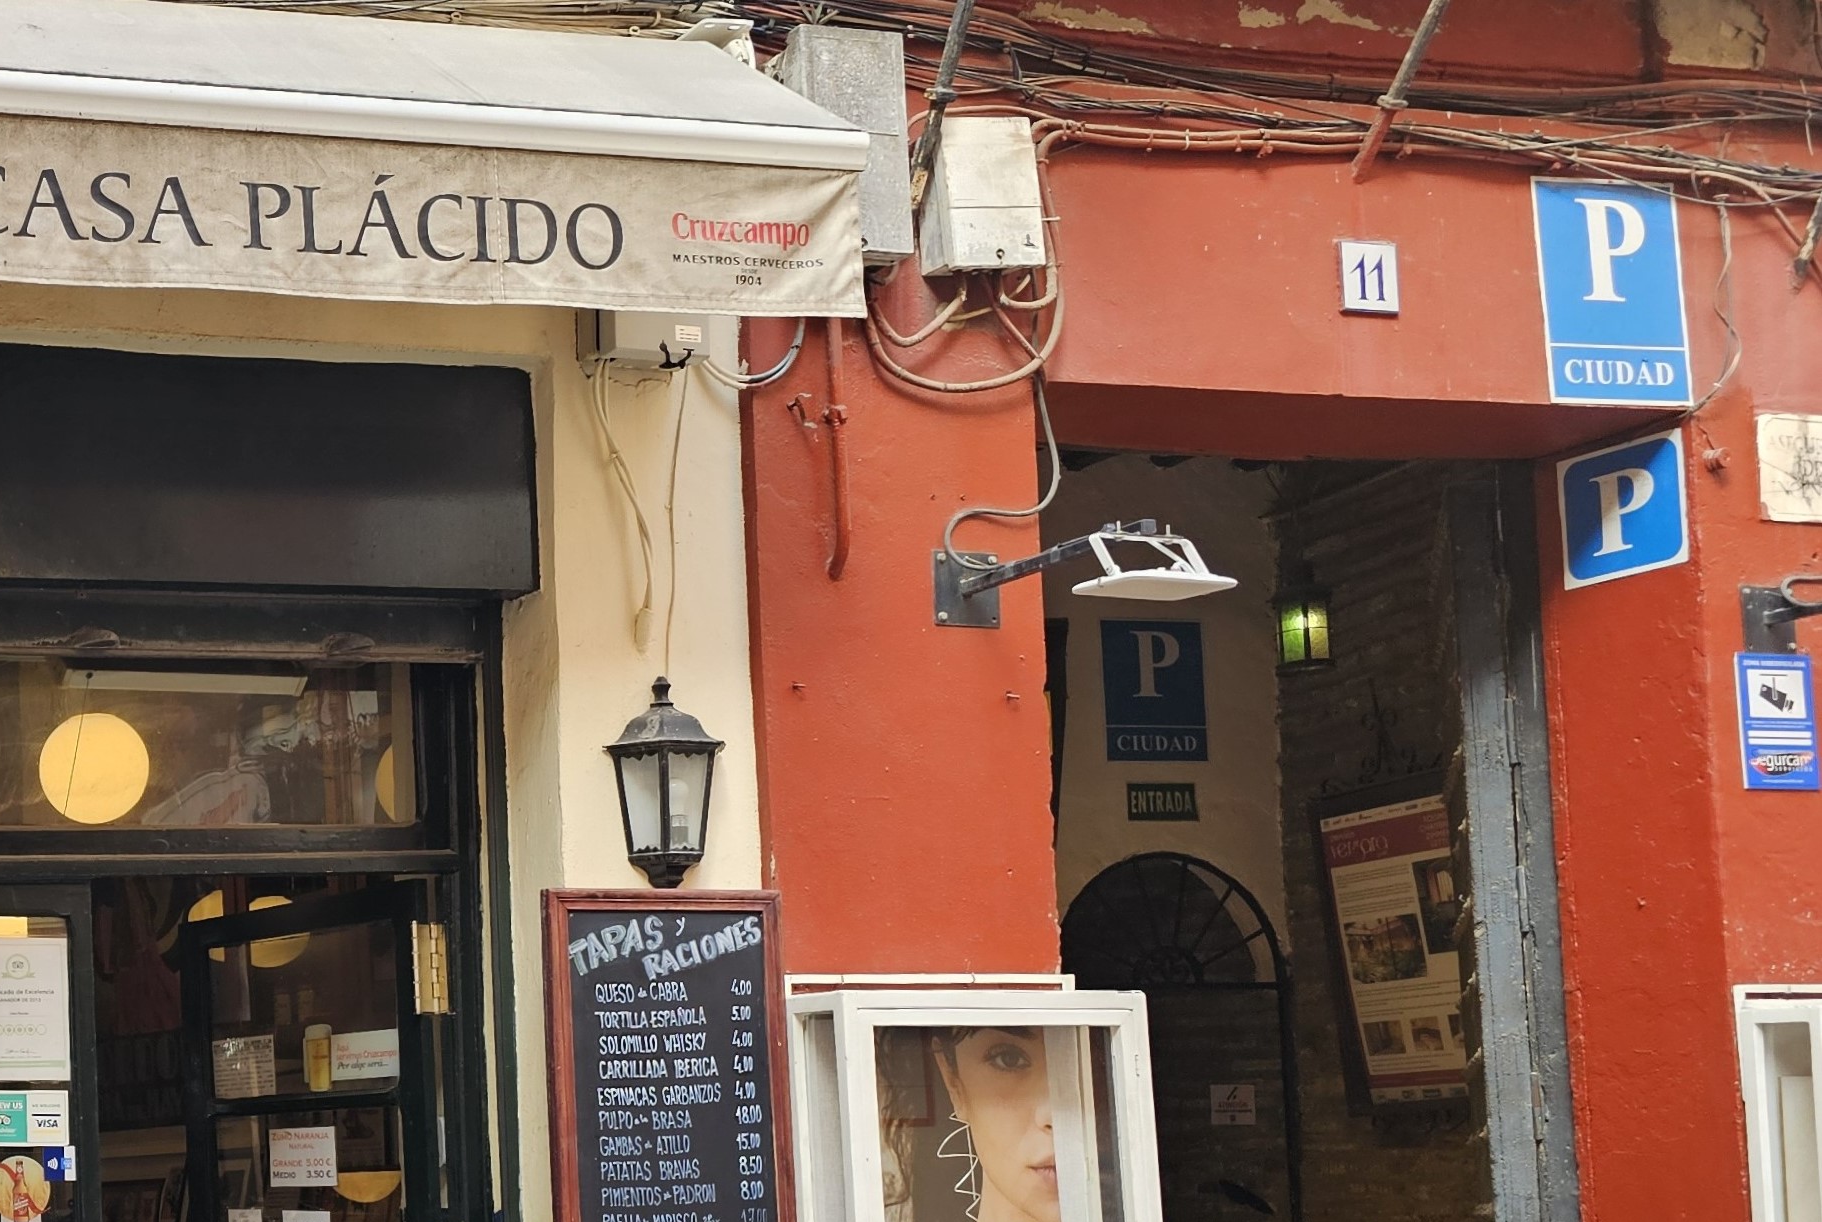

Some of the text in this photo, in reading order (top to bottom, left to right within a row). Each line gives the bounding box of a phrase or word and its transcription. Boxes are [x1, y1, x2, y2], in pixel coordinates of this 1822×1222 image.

[240, 174, 625, 271] PLÁCIDO
[671, 212, 810, 251] Cruzcampo
[672, 253, 824, 270] MAESTROS CERVECEROS
[1574, 198, 1645, 303] P
[735, 274, 762, 286] 1904
[1350, 252, 1386, 302] 11
[1564, 359, 1675, 387] CIUDAD
[1588, 467, 1654, 557] P
[1129, 630, 1180, 698] P
[1116, 734, 1198, 752] CIUDAD
[1130, 791, 1195, 813] ENTRADA
[568, 915, 664, 976] TAPAS
[641, 916, 762, 981] RACIONES
[595, 984, 634, 1004] QUESO
[649, 981, 688, 1001] CABRA
[731, 978, 752, 996] 4.00
[594, 1005, 751, 1029] TORTILLA ESPAÑOLA 5.00
[599, 1029, 753, 1055] SOLOMILLO WHISKY 4.00
[599, 1054, 754, 1079] CARRILLADA IBERICA 4.00
[597, 1081, 756, 1107] ESPINACAS GARBANZOS 4.00
[37, 1119, 58, 1128] VISA
[598, 1111, 633, 1131] PULPO
[652, 1110, 693, 1130] BRASA
[735, 1105, 762, 1125] 18.00
[294, 1130, 329, 1139] NARANJA
[599, 1136, 642, 1156] GAMBAS
[656, 1135, 691, 1155] AJILLO
[736, 1133, 761, 1151] 15.00
[272, 1159, 303, 1167] GRANDE
[273, 1170, 296, 1179] MEDIO
[601, 1155, 763, 1181] PATATAS BRAVAS 8.50
[601, 1180, 764, 1207] PIMIENTOS PADRON 8.00
